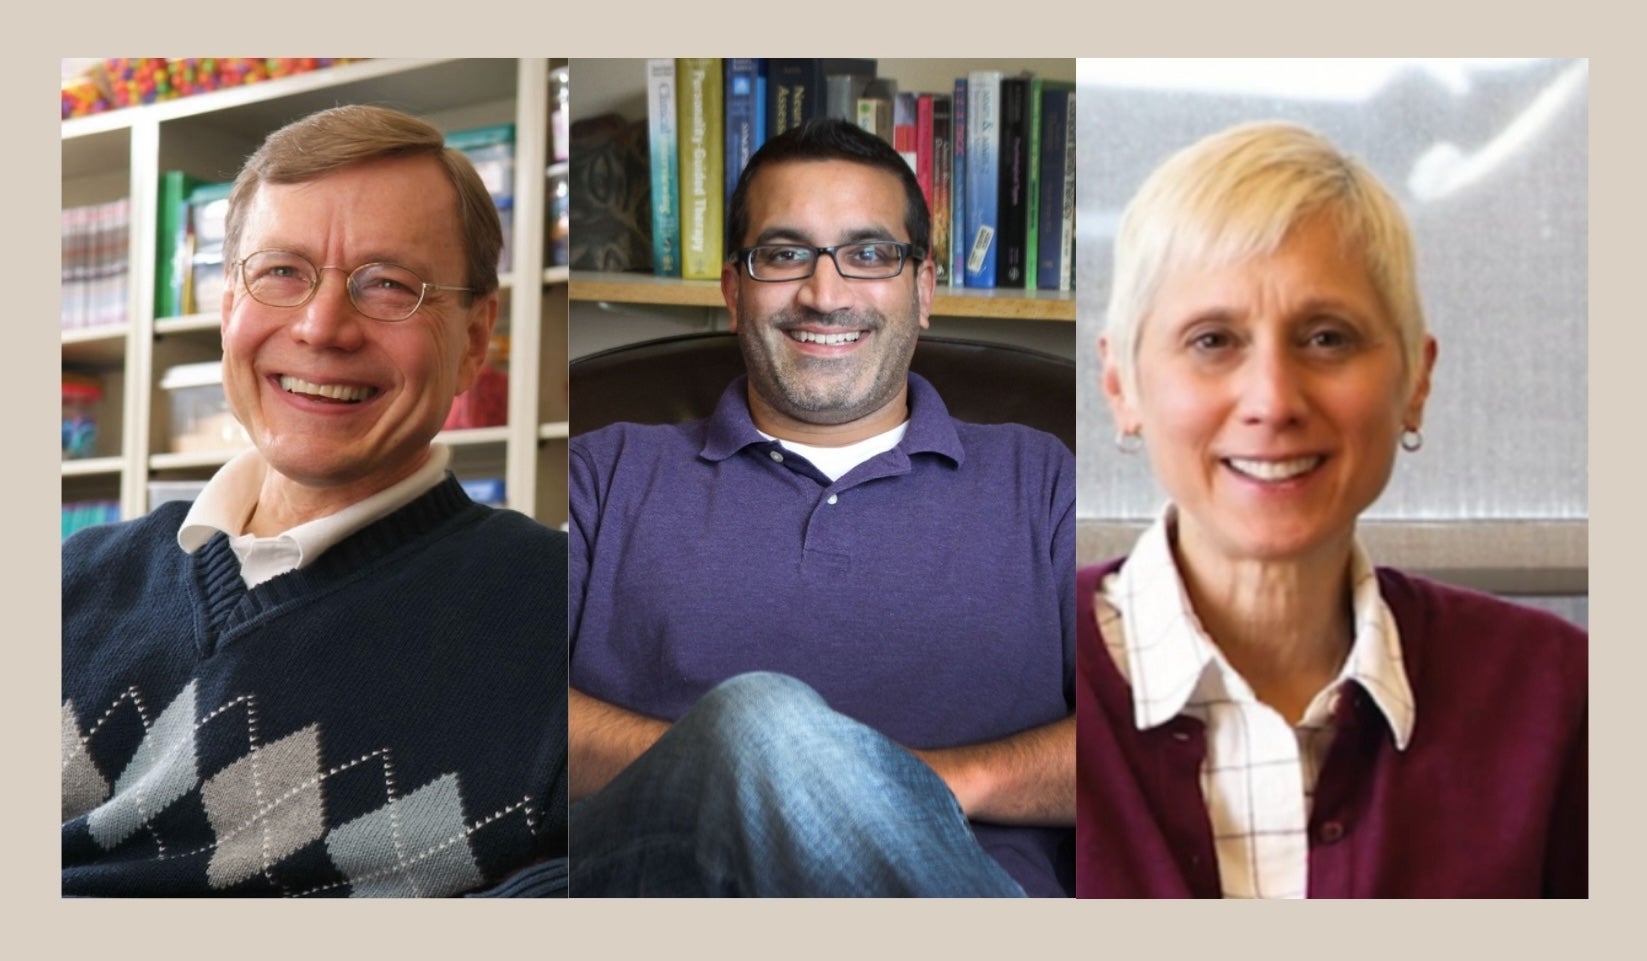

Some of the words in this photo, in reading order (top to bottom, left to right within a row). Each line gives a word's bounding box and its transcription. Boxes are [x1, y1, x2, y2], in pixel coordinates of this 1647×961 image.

[691, 69, 707, 195] Personality-Guided
[777, 84, 790, 137] Assess
[792, 84, 806, 129] Neuro
[690, 198, 707, 252] Therapy
